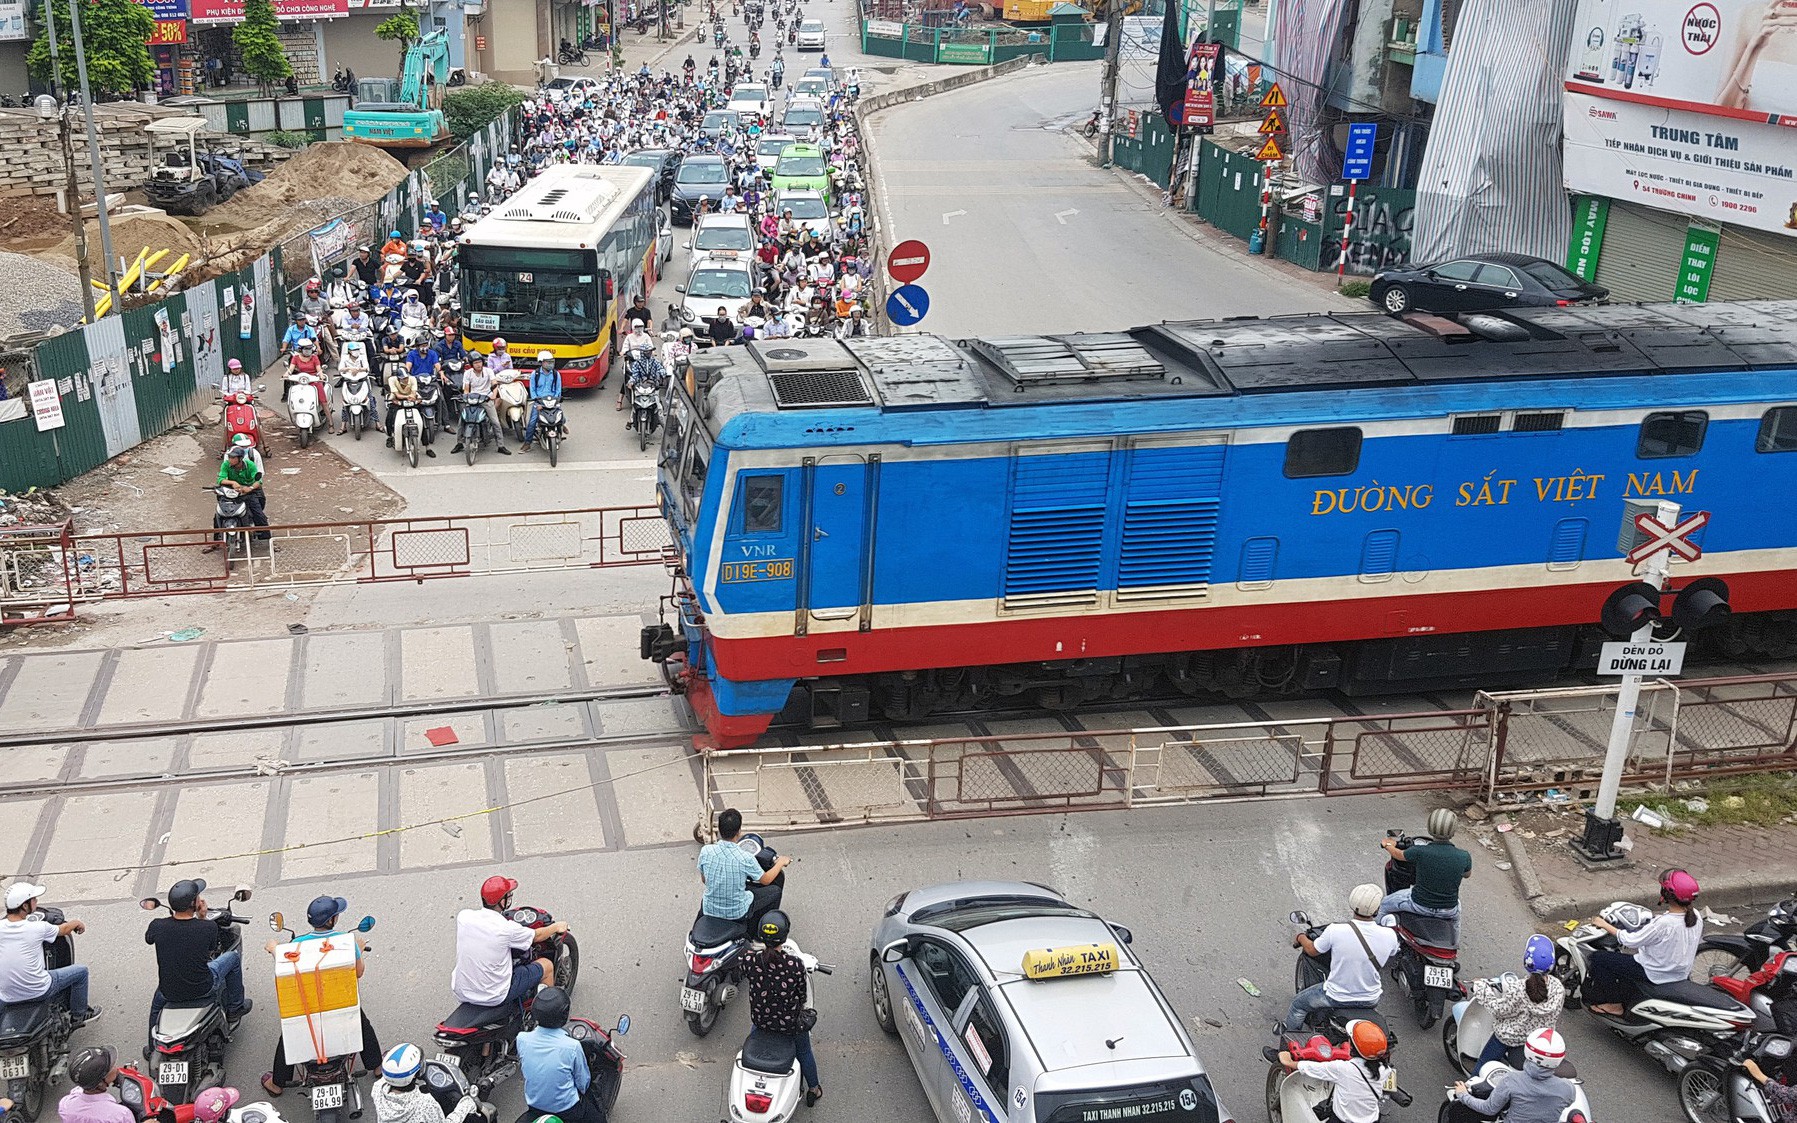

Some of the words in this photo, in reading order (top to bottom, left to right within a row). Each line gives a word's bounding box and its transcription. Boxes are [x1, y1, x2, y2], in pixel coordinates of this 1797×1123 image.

[161, 22, 182, 42] 50%
[1598, 110, 1617, 120] SAWA
[1650, 124, 1700, 146] TRUNG
[1705, 132, 1739, 151] TÂM
[1604, 138, 1622, 149] TIẾP
[1624, 142, 1646, 154] NHẬN
[1648, 146, 1668, 157] DỊCH
[1670, 150, 1682, 160] VỤ
[1676, 192, 1696, 202] CHINH
[1722, 200, 1738, 210] 1900
[1688, 258, 1707, 269] THAY
[520, 273, 532, 282] 24
[1684, 284, 1698, 296] LỌC
[1310, 479, 1434, 514] ĐƯỜNG
[1456, 469, 1517, 506] SẮT
[1533, 468, 1605, 507] VIỆT
[1622, 470, 1699, 497] NAM
[741, 544, 776, 557] VNR
[725, 562, 792, 580] D19E-908
[1610, 656, 1648, 670] DỪNG
[1650, 659, 1672, 672] LẠI
[1034, 956, 1056, 974] Thanh
[1081, 950, 1110, 964] TAXI
[1060, 962, 1111, 974] 32.215.215
[1426, 976, 1451, 986] 917.58
[3, 1066, 25, 1078] 0631
[160, 1074, 187, 1084] 983.70
[314, 1096, 341, 1108] 984.99
[1014, 1088, 1026, 1108] 154
[1181, 1092, 1196, 1106] 154
[1083, 1110, 1098, 1122] TAXI
[1100, 1108, 1122, 1120] THANH
[1122, 1104, 1140, 1117] NHAN
[1142, 1100, 1175, 1114] 32.215.215
